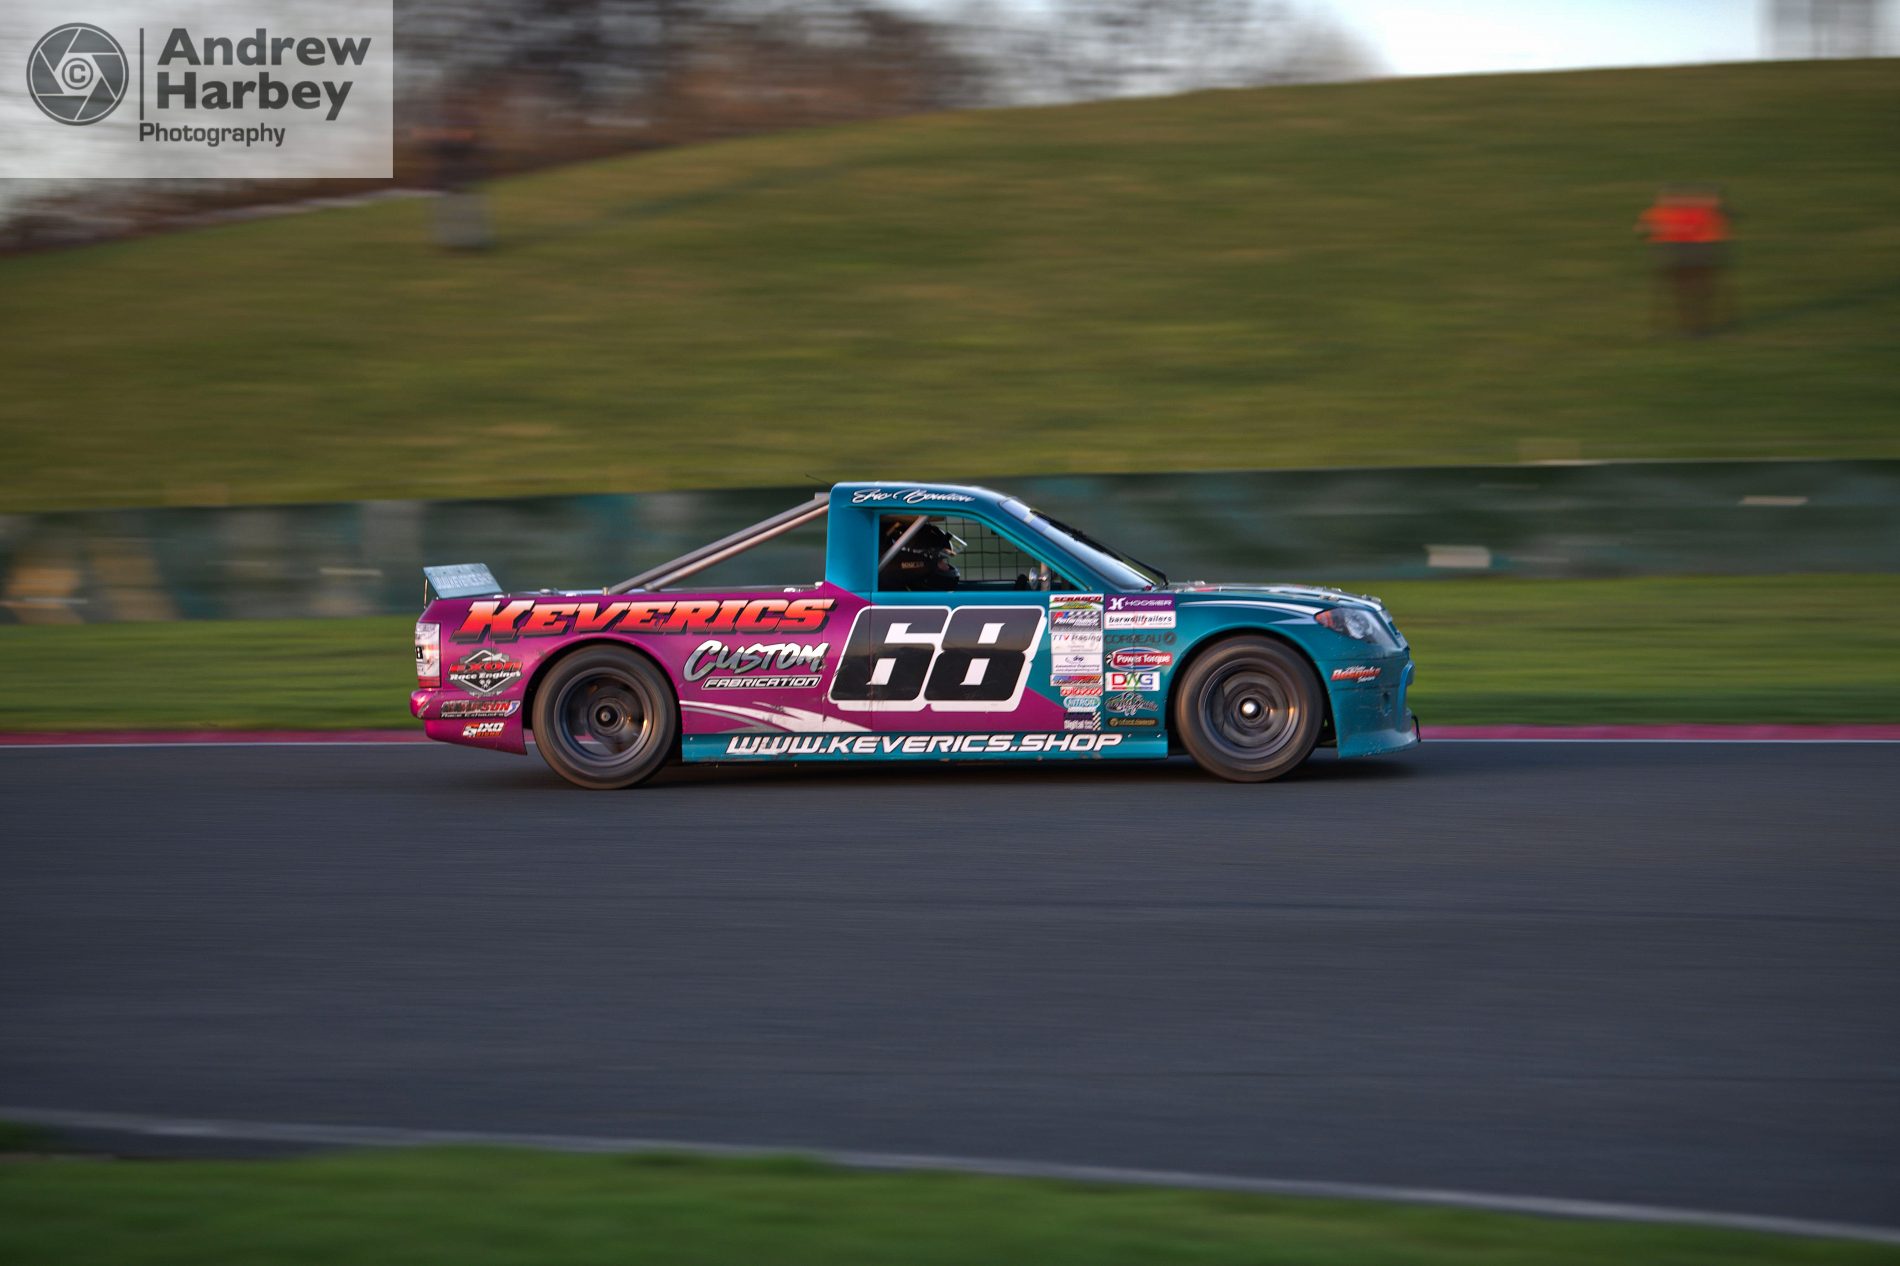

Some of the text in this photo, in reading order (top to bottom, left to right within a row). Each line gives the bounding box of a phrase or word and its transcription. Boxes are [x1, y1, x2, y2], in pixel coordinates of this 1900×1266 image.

[1124, 599, 1172, 607] HOOSIER
[452, 599, 837, 642] KEVERICS
[1072, 634, 1102, 642] Racing
[1104, 633, 1162, 645] CORBEAU
[828, 606, 1047, 713] 68
[1116, 654, 1171, 665] Power Torque
[450, 671, 521, 681] Race Engines
[1111, 673, 1153, 686] DWG
[704, 677, 818, 688] FABRICATION
[726, 733, 1123, 756] WWW.KEVERICS.SHOP
